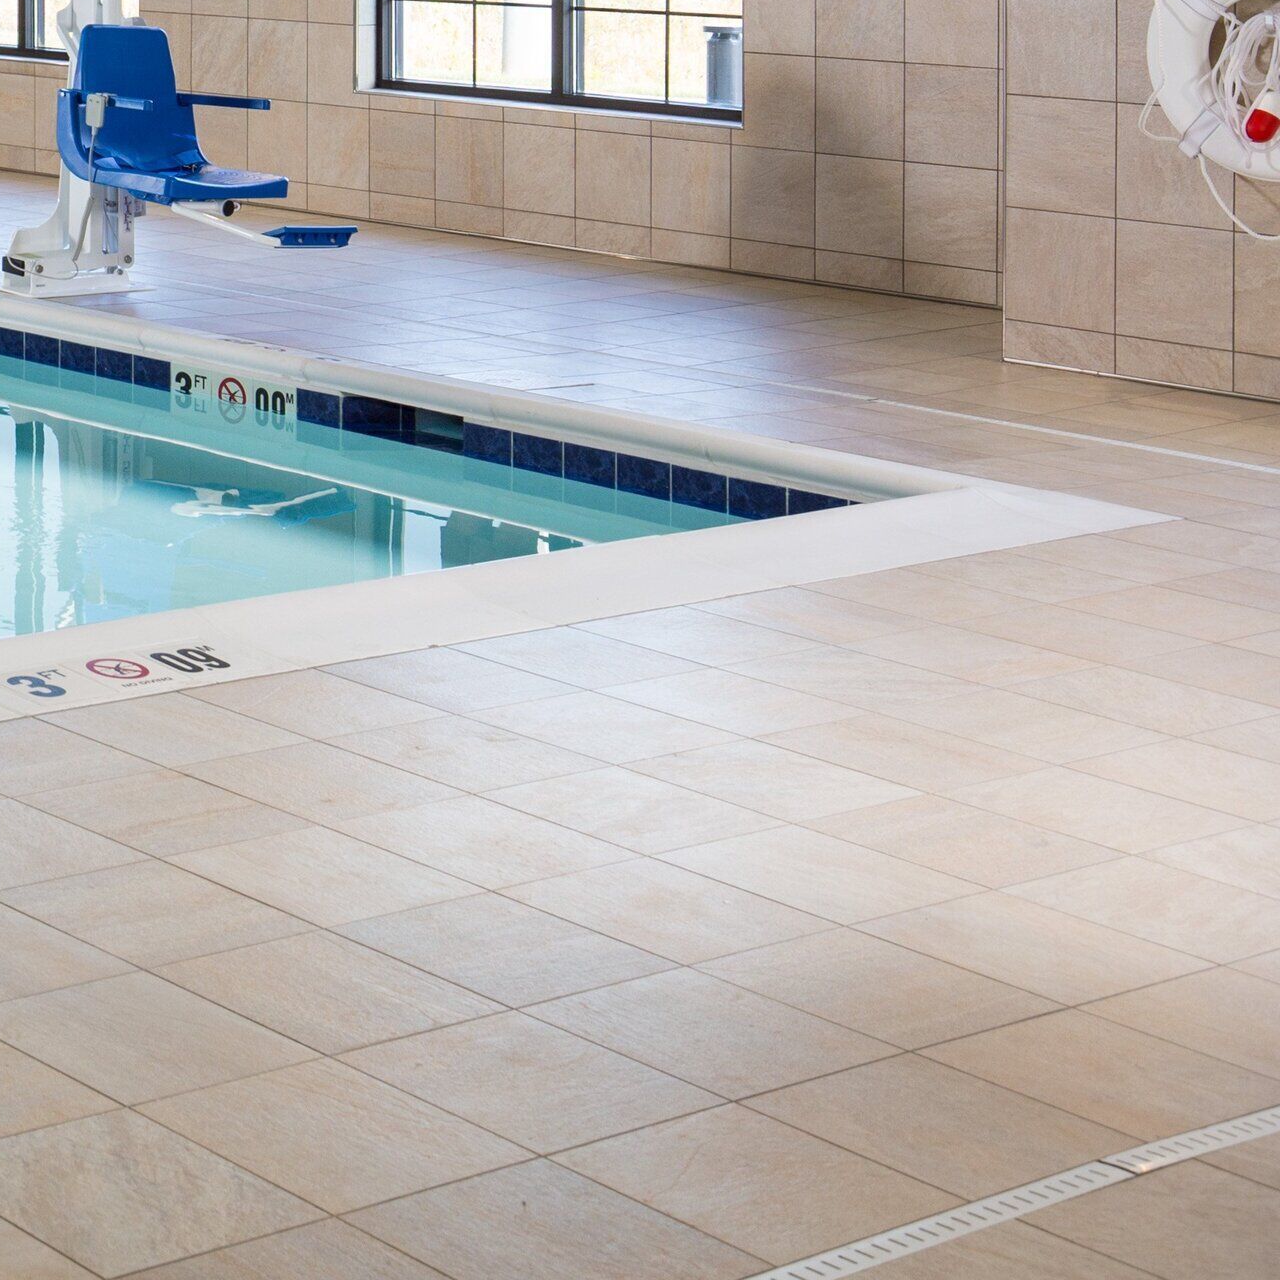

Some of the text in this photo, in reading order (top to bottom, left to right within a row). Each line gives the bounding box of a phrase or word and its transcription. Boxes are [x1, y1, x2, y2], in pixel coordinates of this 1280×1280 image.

[194, 374, 207, 390] FT
[286, 392, 294, 405] M
[36, 668, 67, 680] FT
[6, 675, 67, 698] 3
